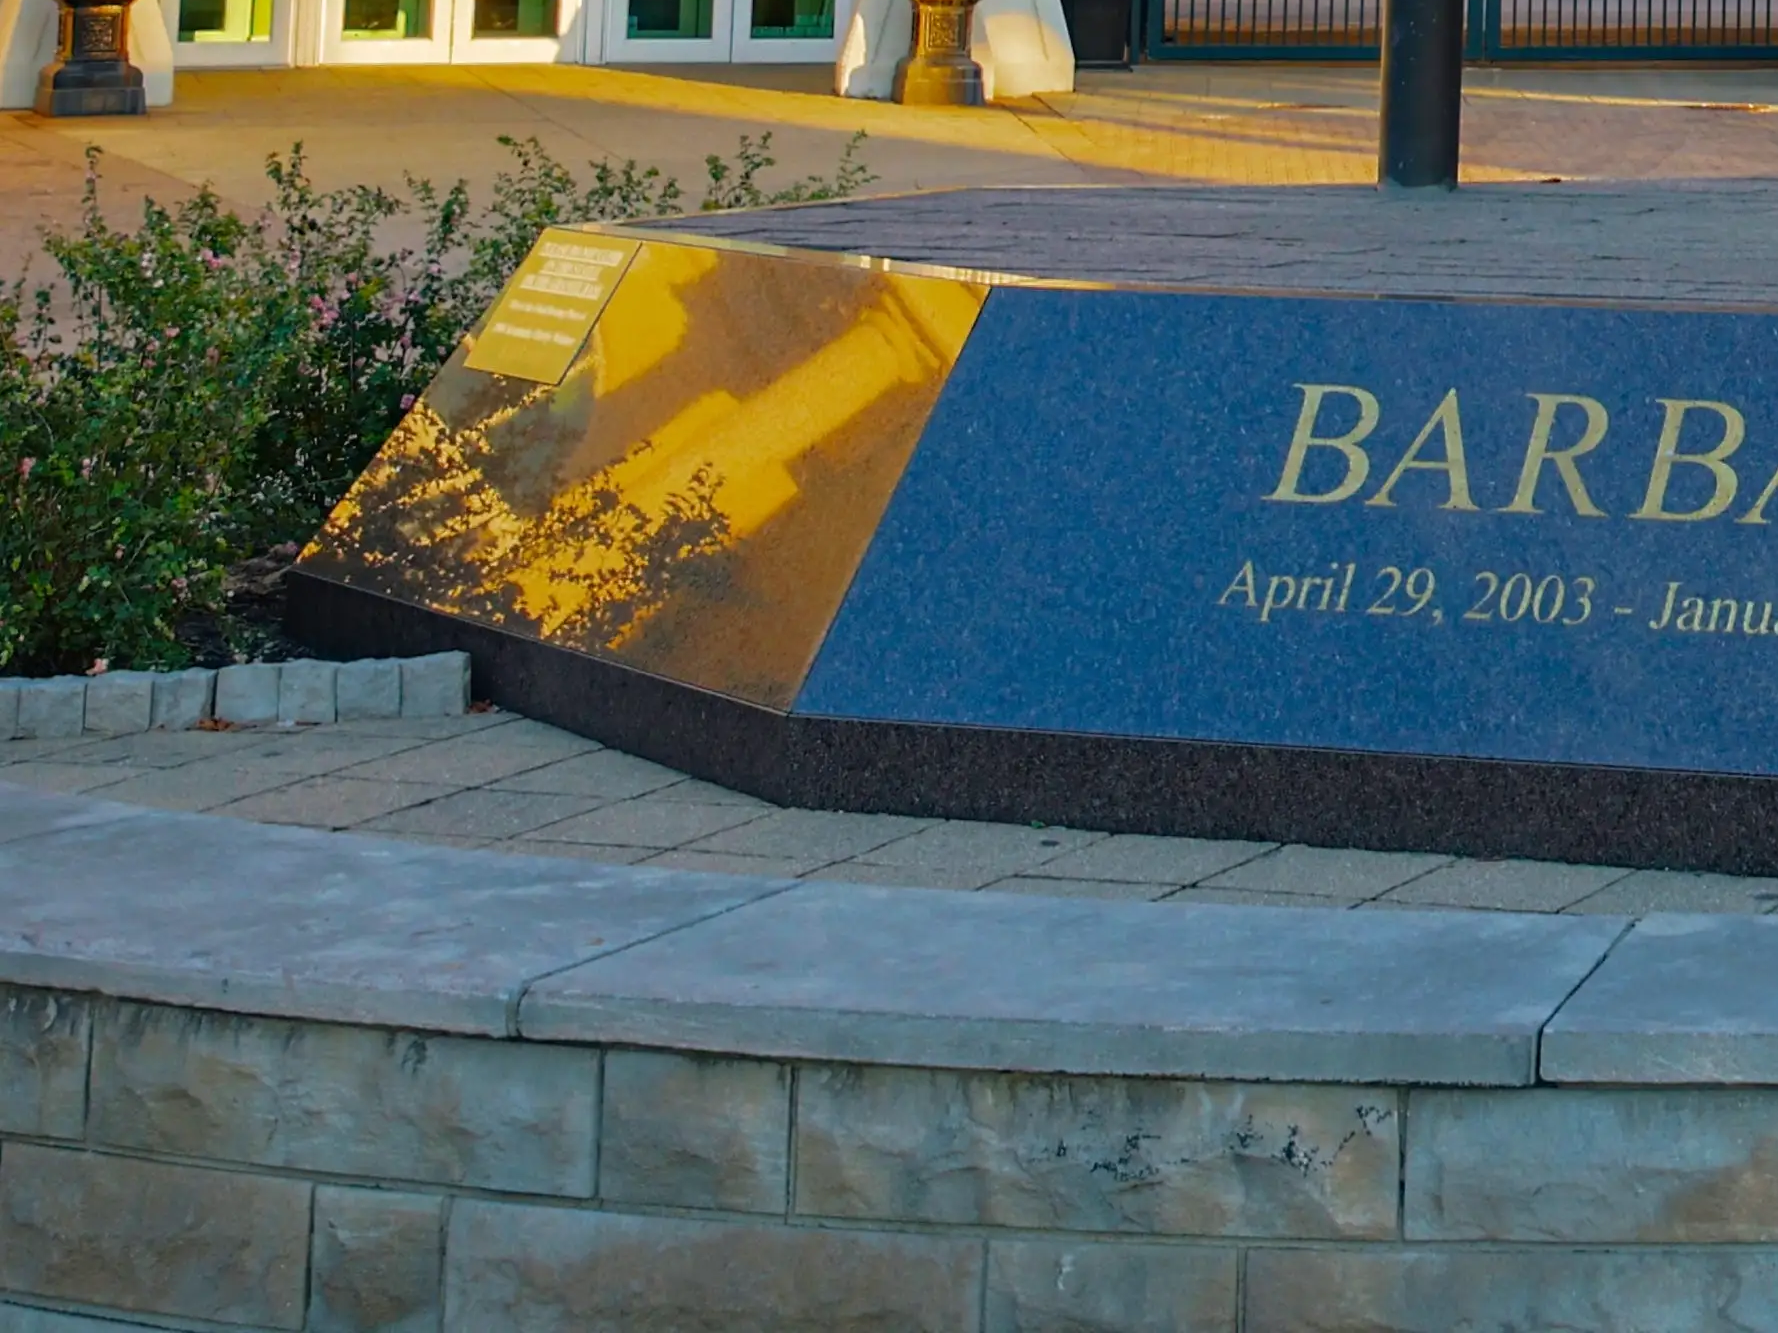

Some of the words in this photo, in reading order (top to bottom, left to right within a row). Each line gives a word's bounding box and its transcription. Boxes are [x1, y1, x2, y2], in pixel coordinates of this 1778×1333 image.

[1218, 559, 1357, 622] April
[1374, 567, 1443, 626] 29,
[1462, 571, 1596, 626] 2003
